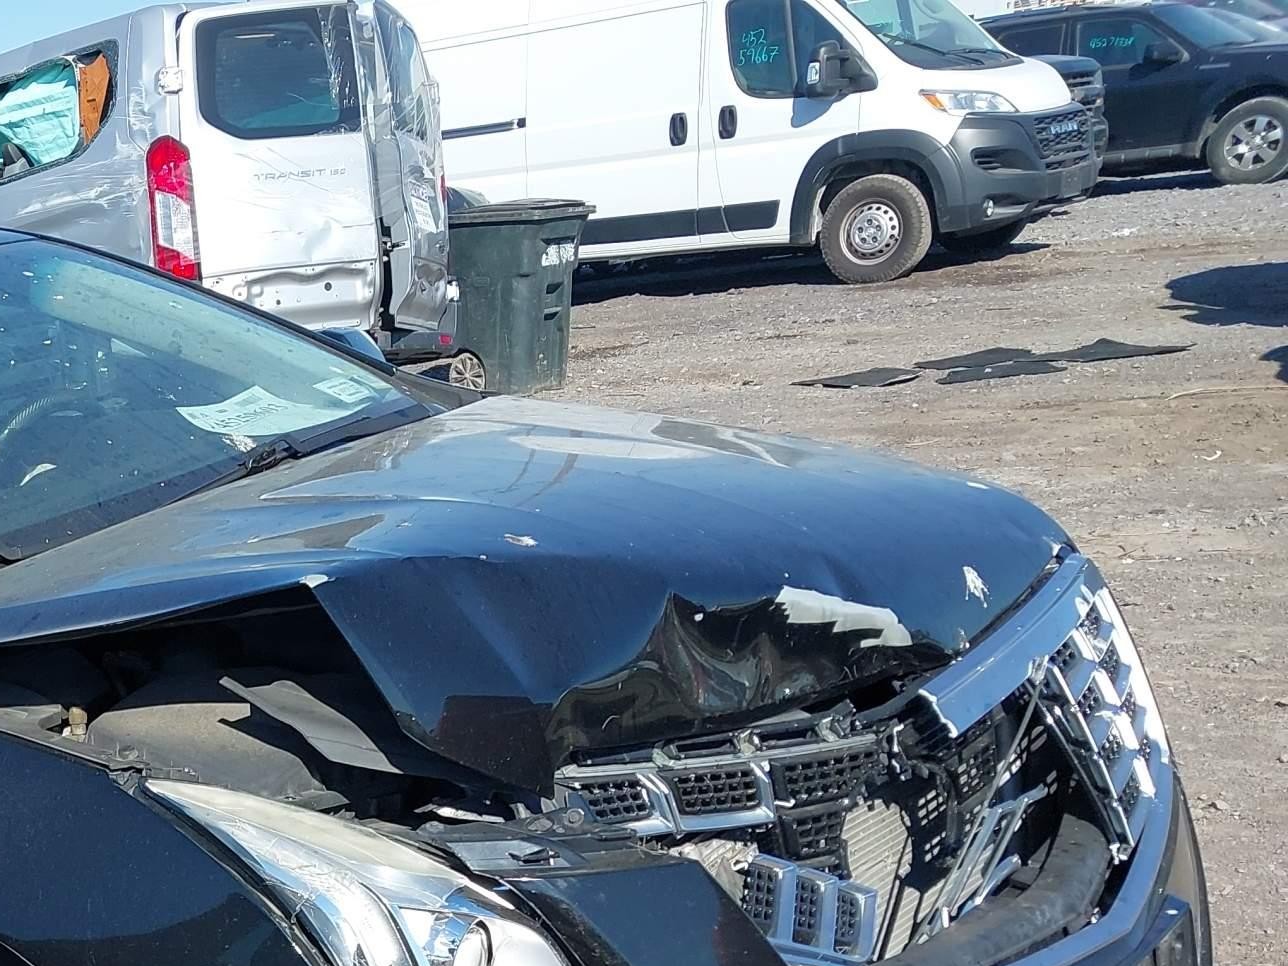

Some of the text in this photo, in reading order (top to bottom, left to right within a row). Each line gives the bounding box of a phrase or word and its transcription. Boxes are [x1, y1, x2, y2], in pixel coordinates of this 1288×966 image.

[742, 28, 767, 47] 452
[737, 46, 780, 65] 59667
[253, 168, 326, 180] TRANSIT
